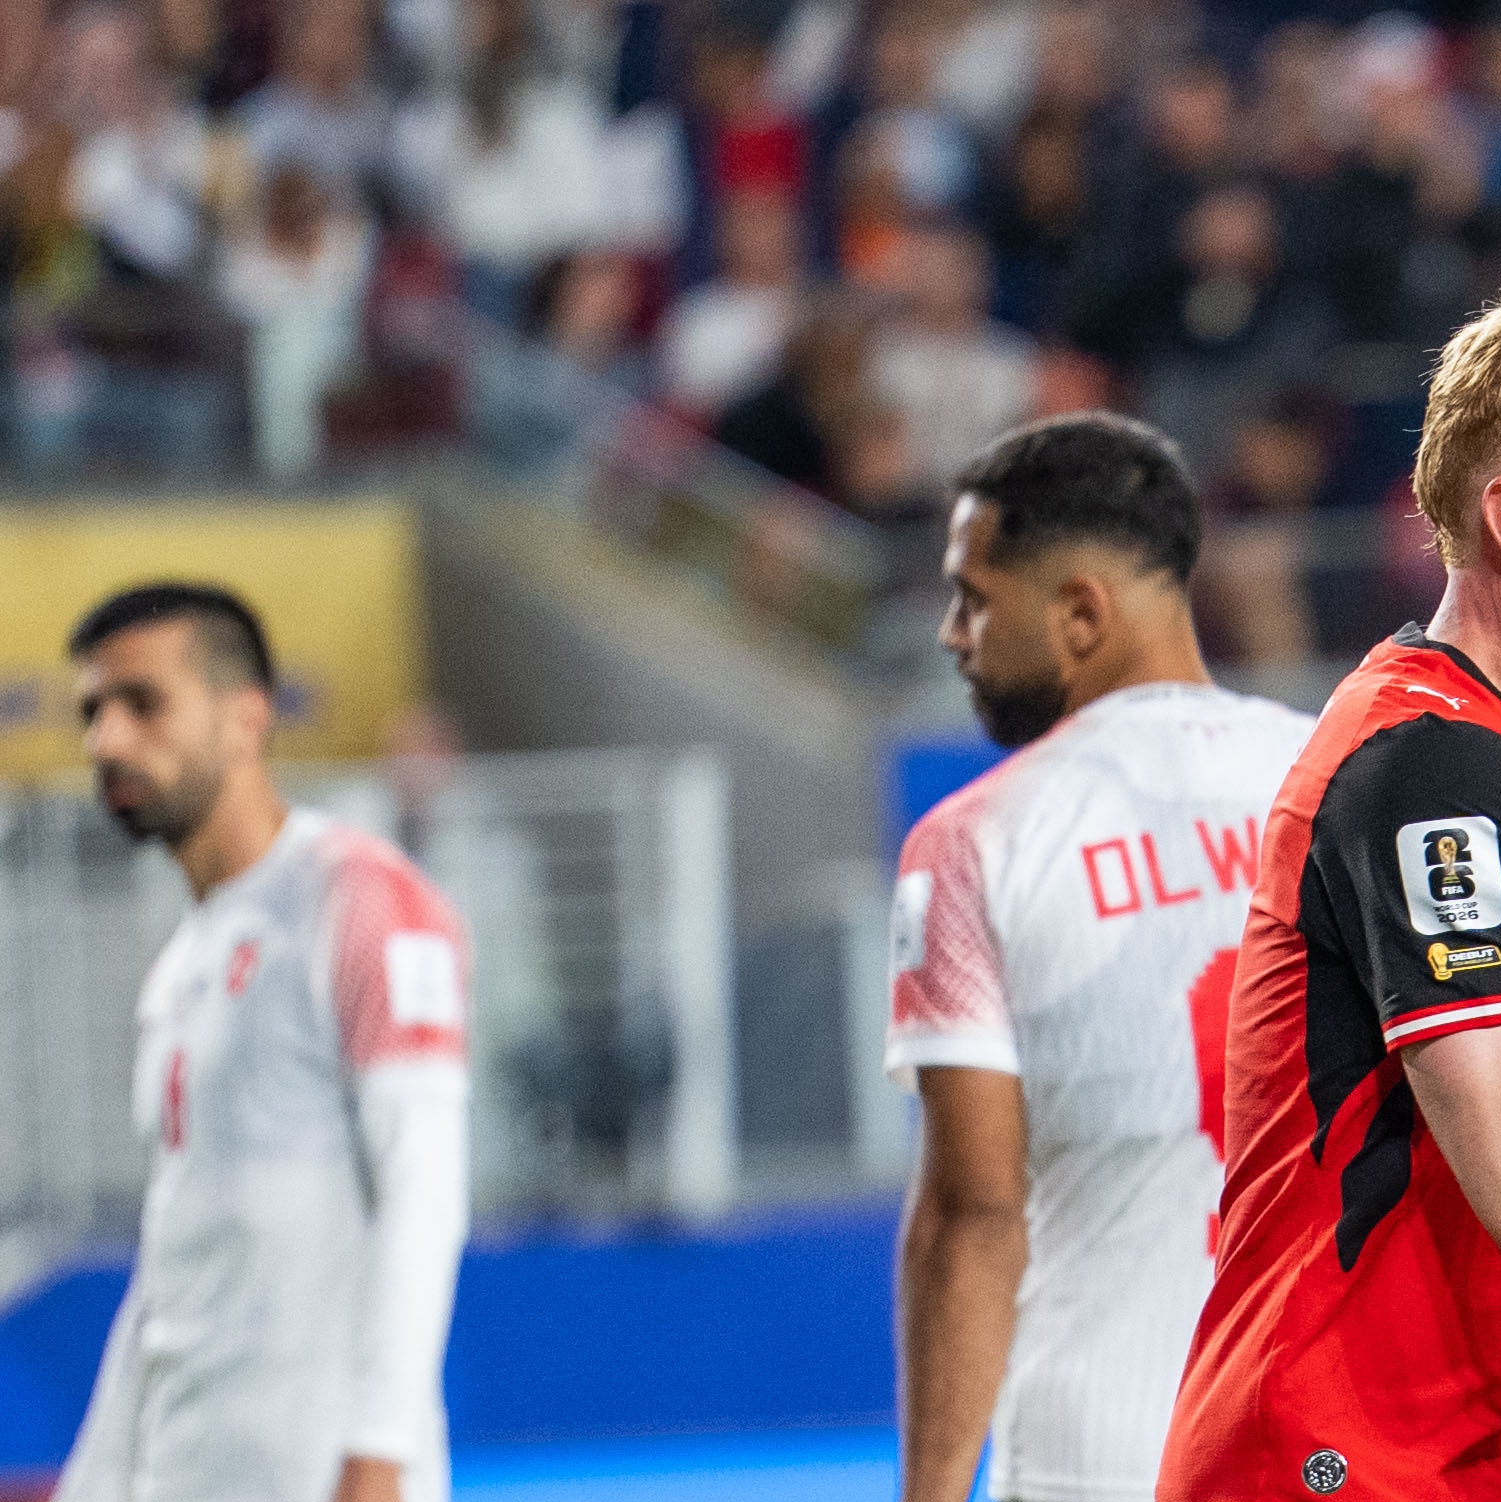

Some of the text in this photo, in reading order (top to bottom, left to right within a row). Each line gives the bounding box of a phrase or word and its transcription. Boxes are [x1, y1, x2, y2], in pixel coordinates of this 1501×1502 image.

[1442, 885, 1465, 896] FIFA
[1433, 901, 1479, 913] WORLD CUP
[1436, 909, 1480, 923] 2026
[1448, 948, 1495, 962] DEBUT
